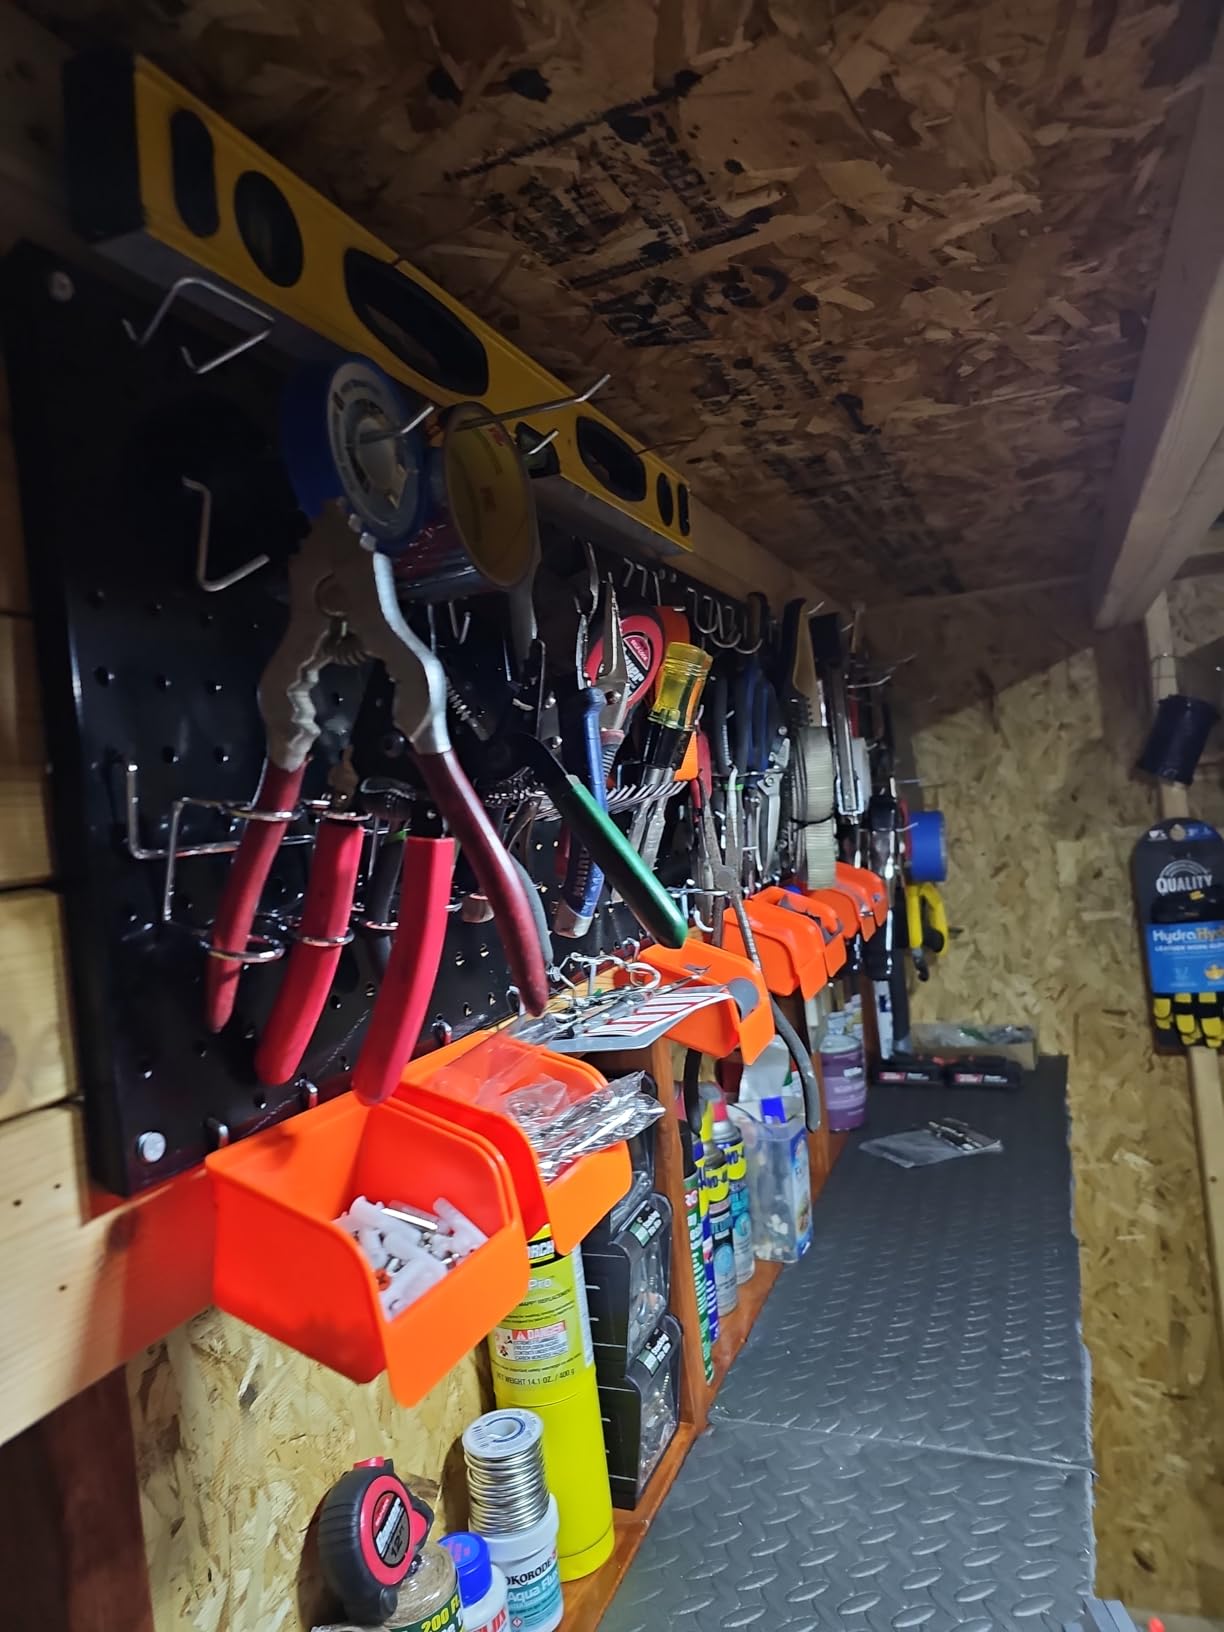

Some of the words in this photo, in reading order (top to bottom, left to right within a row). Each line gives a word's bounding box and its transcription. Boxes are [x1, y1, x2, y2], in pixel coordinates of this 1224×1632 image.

[1156, 874, 1213, 896] QUALITY
[528, 1322, 564, 1340] DANGER
[505, 1375, 526, 1386] WEIGHT
[542, 1375, 554, 1385] OZ.
[559, 1368, 571, 1379] 400
[390, 1533, 404, 1558] 12
[507, 1585, 541, 1605] Aqua
[420, 1607, 450, 1632] 200
